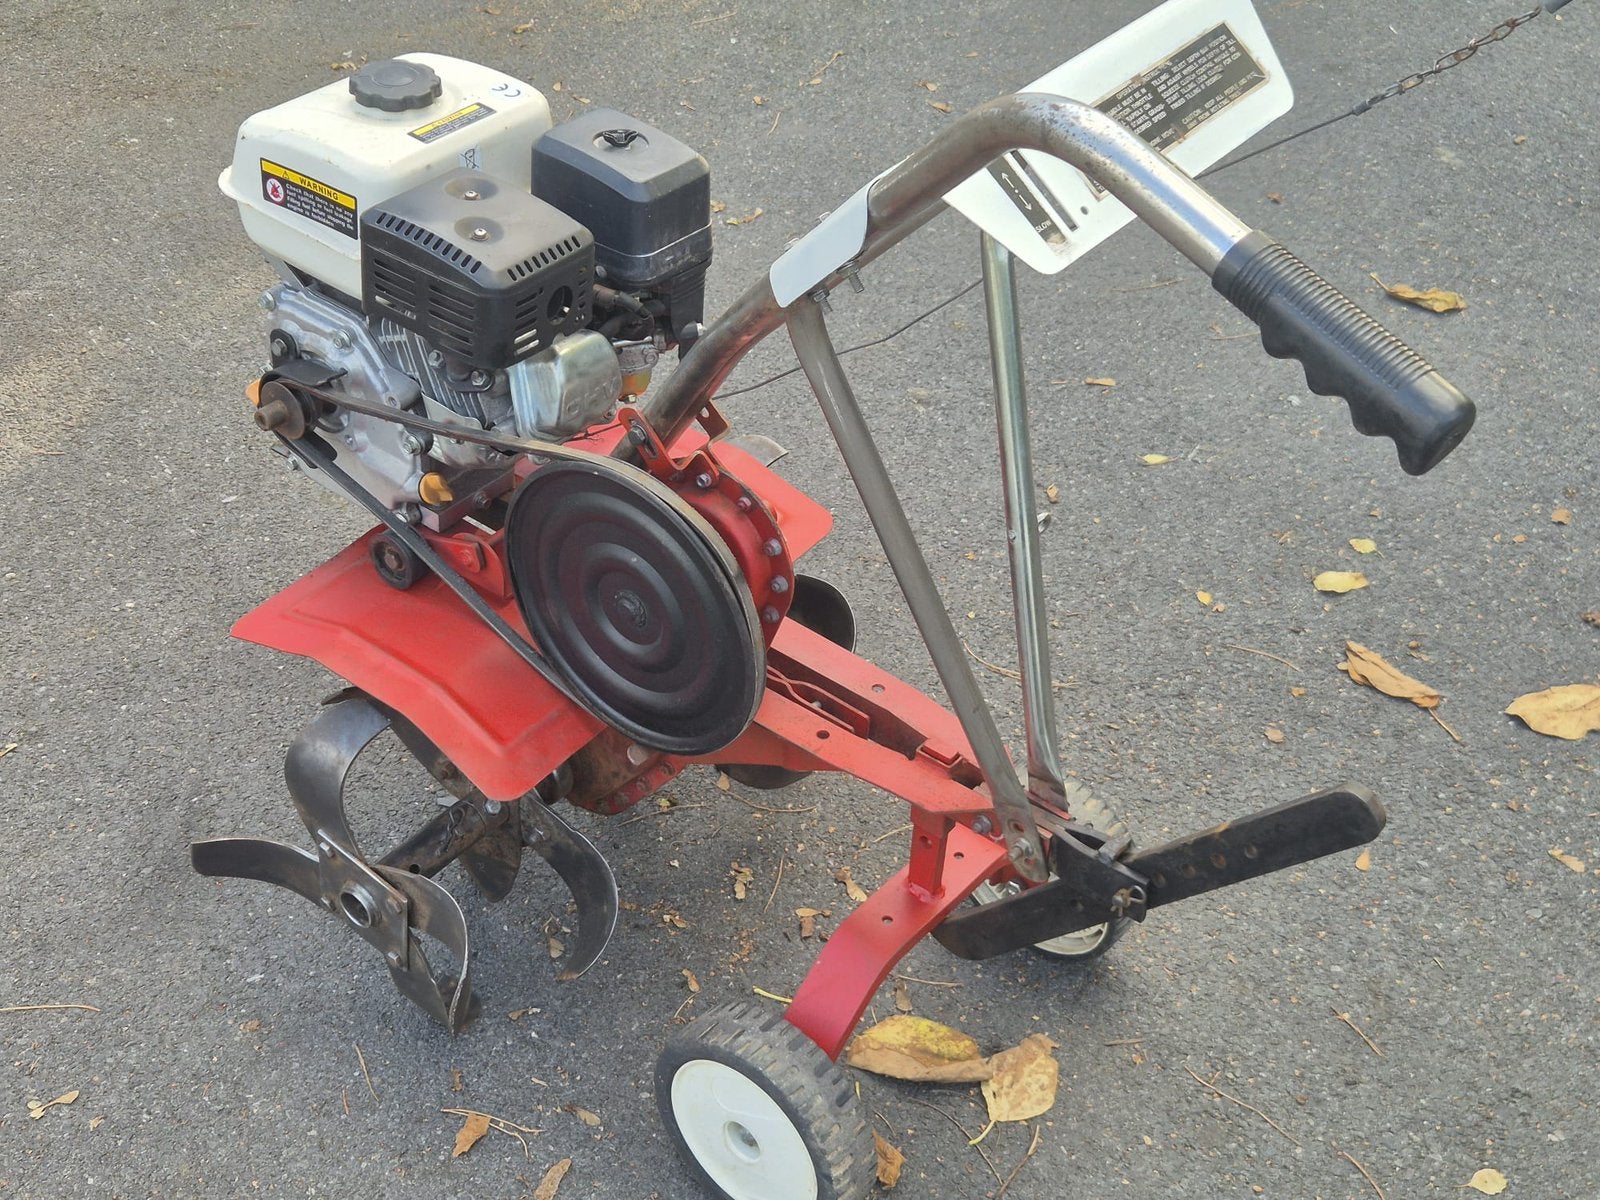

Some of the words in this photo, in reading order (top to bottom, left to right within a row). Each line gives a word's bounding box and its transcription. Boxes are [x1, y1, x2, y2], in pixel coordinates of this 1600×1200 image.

[1171, 60, 1187, 74] SELECT
[1186, 51, 1201, 63] DEPTH
[1157, 83, 1167, 93] AND
[1166, 72, 1182, 86] ADJUST
[1197, 56, 1208, 65] FOR
[1161, 83, 1181, 99] SQUEEZE
[1180, 73, 1197, 87] CLUTCH
[1195, 61, 1215, 75] CONTROL
[1165, 92, 1180, 105] START
[1196, 74, 1208, 84] LOCK
[1185, 86, 1202, 100] TILLING
[1215, 94, 1224, 102] ALL
[299, 177, 339, 200] WARNING
[286, 183, 302, 194] Check
[303, 191, 314, 199] that
[315, 196, 328, 206] there
[344, 210, 353, 218] any
[1035, 220, 1051, 232] SLOW
